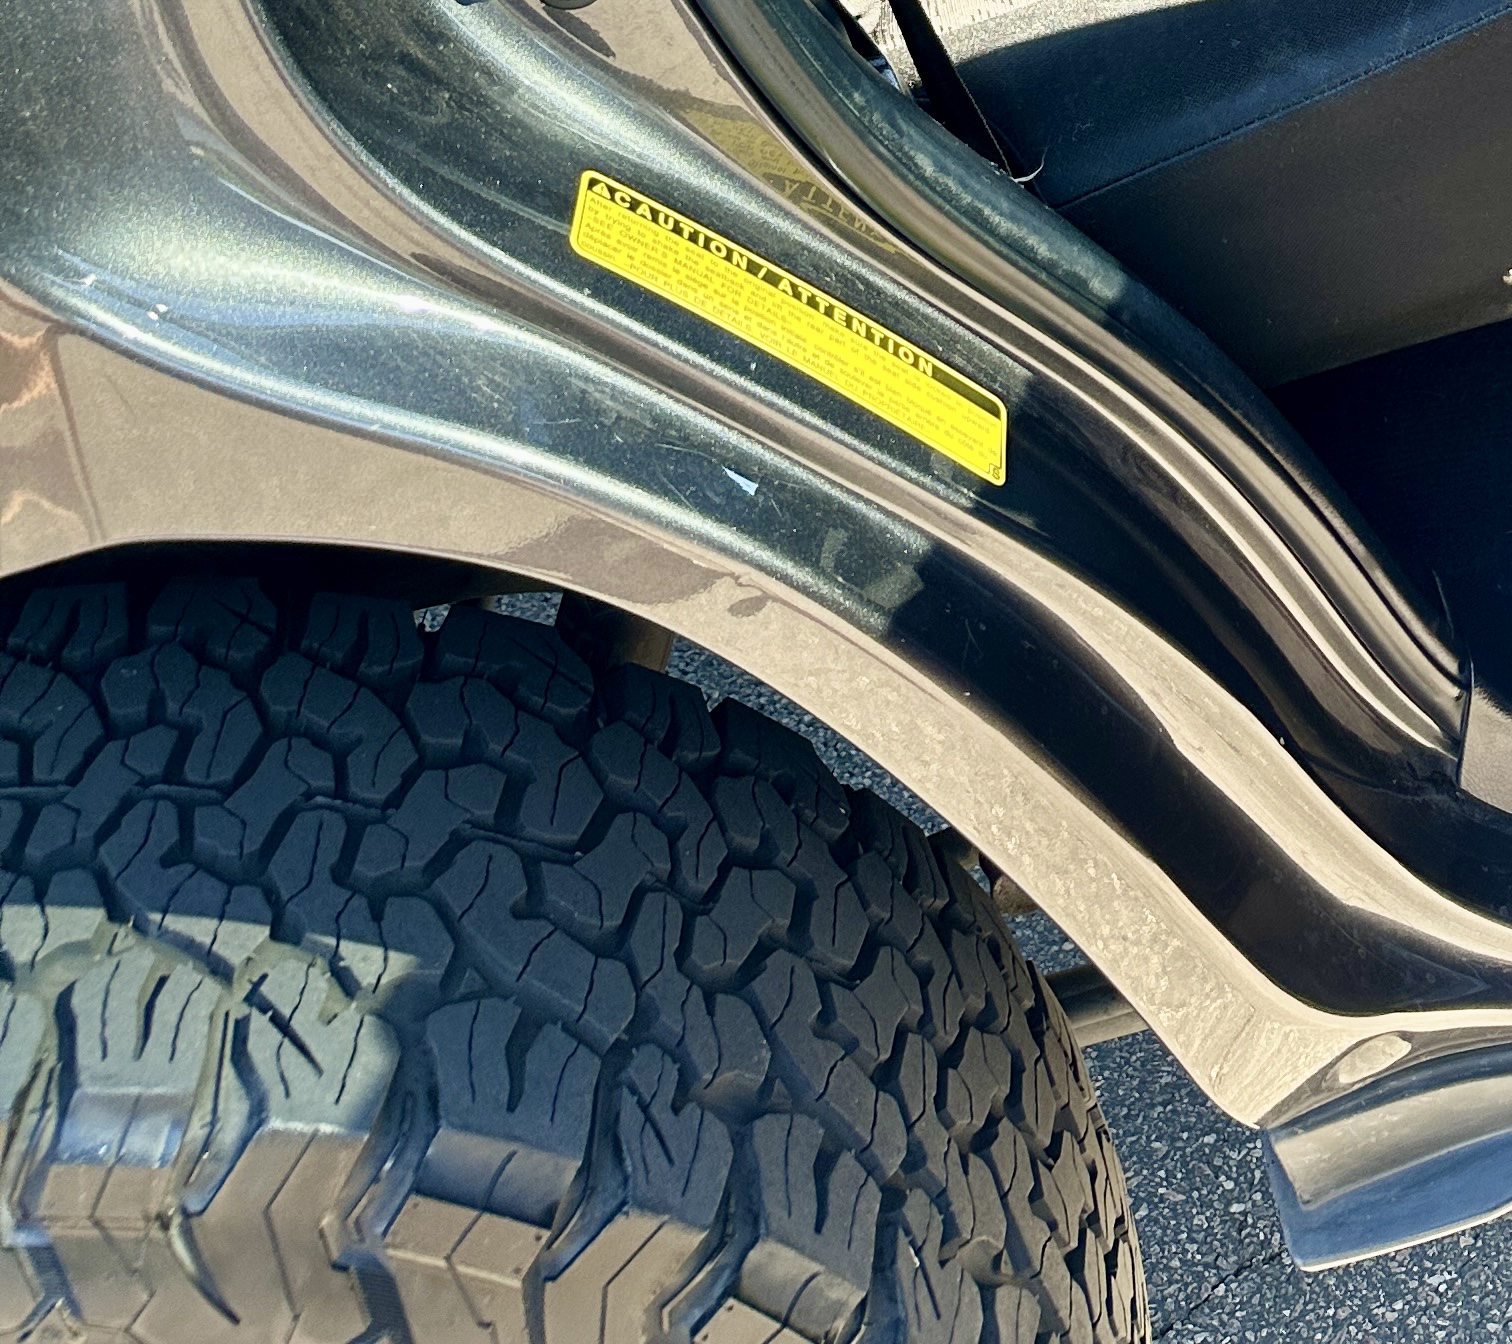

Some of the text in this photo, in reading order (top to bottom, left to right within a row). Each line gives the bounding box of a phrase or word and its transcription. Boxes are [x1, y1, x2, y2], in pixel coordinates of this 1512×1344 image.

[605, 214, 631, 232] trying
[652, 238, 679, 255] shake
[685, 254, 699, 266] the
[750, 290, 767, 302] and
[788, 310, 801, 322] the
[807, 322, 823, 333] rear
[864, 354, 877, 365] the
[882, 365, 899, 377] seat
[615, 191, 932, 376] CAUTION / ATTENTION
[665, 235, 679, 246] the
[724, 266, 738, 277] the
[743, 278, 776, 298] original
[674, 257, 713, 283] MANUAL
[721, 282, 741, 297] FOR
